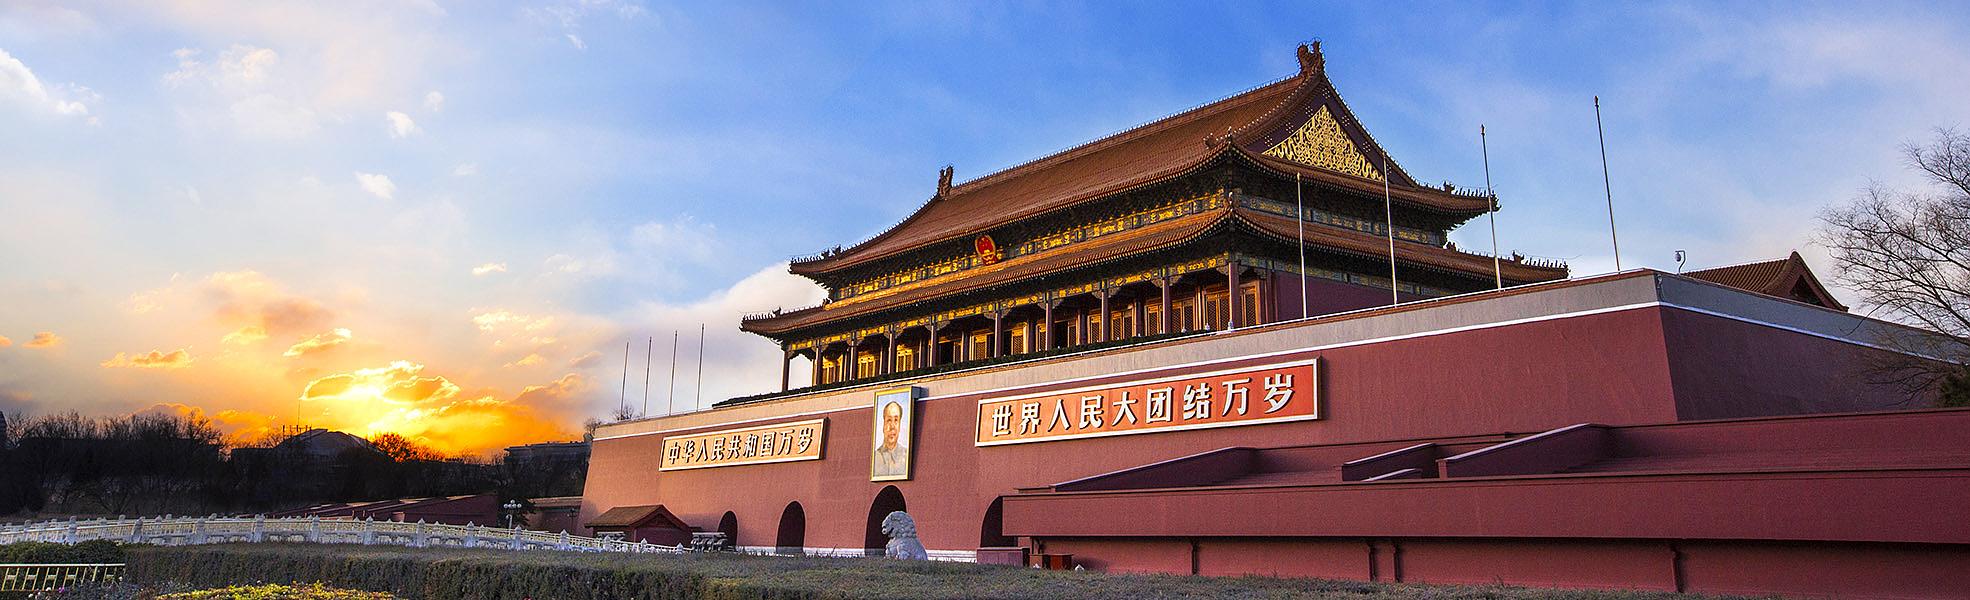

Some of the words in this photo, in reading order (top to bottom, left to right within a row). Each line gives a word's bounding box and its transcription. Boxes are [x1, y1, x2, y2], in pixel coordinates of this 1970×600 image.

[991, 373, 1296, 437] 世界人民大团结万岁
[668, 427, 814, 465] 中华人民共和国万岁
